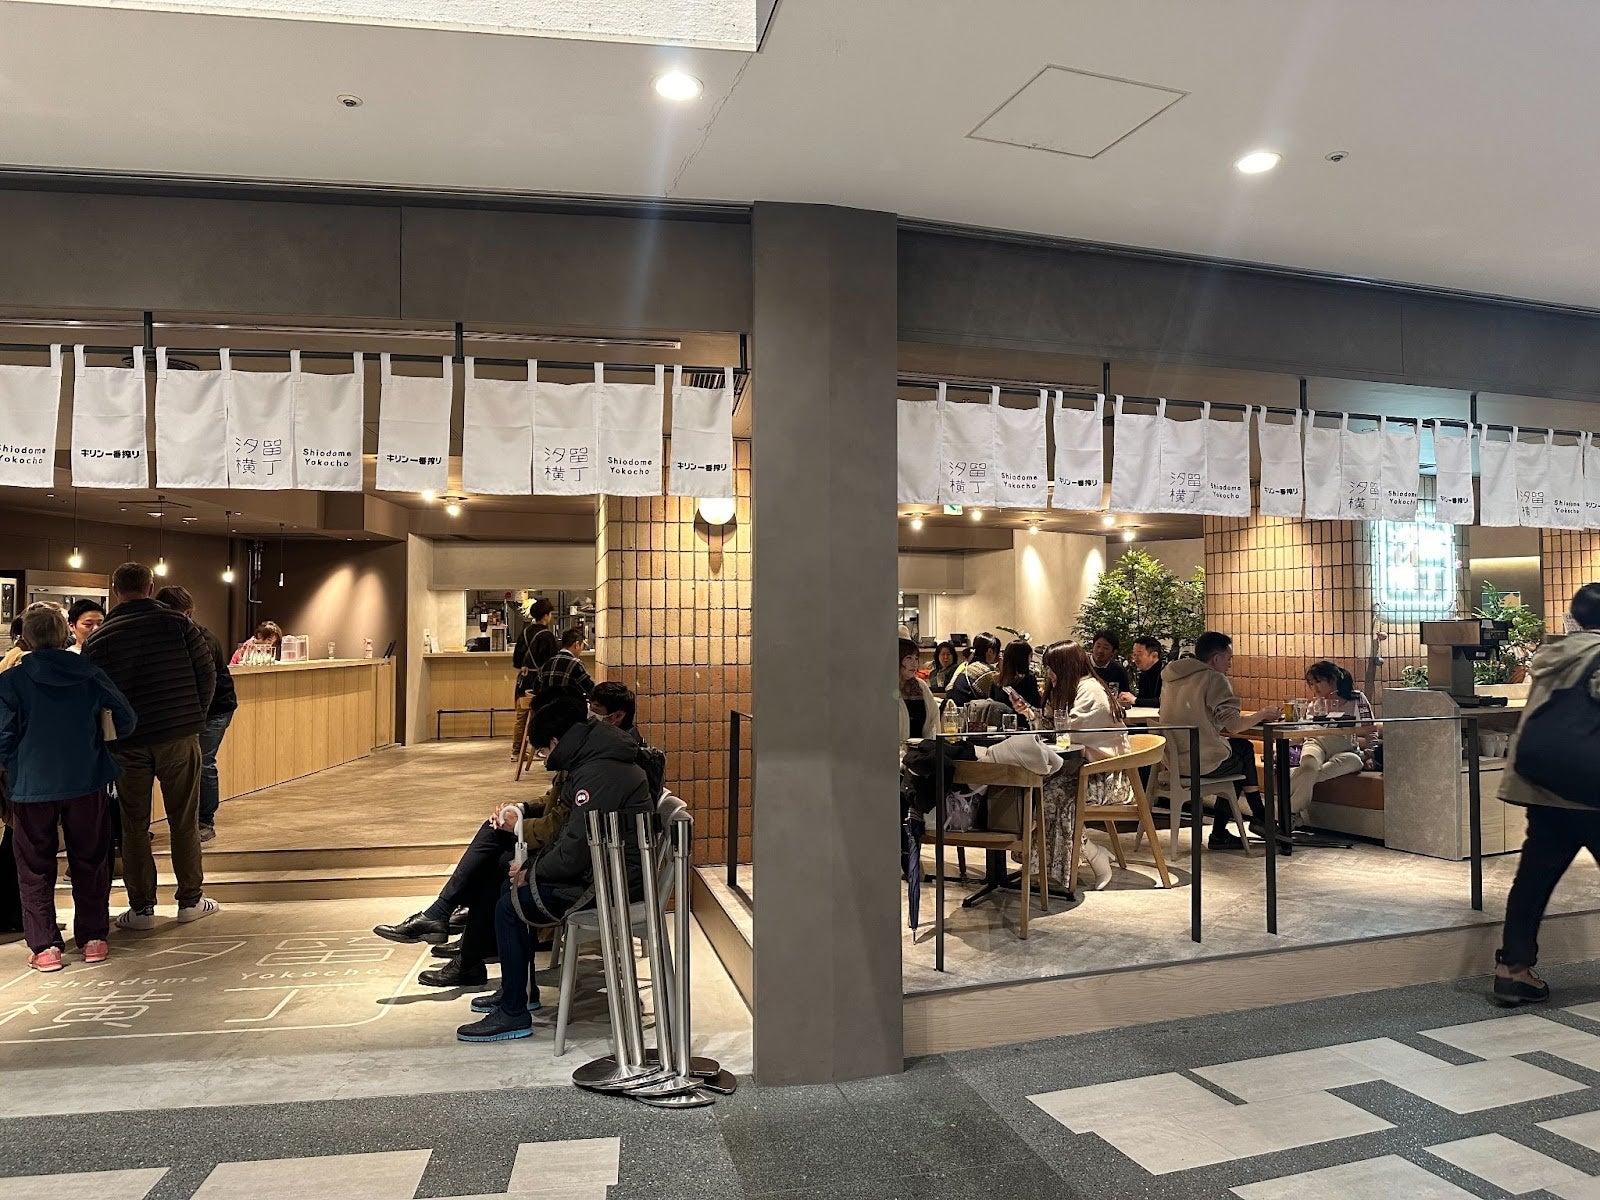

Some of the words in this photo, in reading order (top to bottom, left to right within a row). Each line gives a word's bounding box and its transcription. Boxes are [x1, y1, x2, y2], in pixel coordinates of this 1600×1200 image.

[0, 444, 46, 454] hiodome
[235, 437, 282, 456] 汐留
[81, 449, 140, 459] キリン一番搾り
[302, 448, 352, 457] Shiodome
[544, 446, 588, 464] 汐留
[305, 458, 349, 467] Yokocho
[386, 454, 442, 465] キリン一番搾り
[607, 456, 653, 466] Shiodome
[235, 457, 282, 476] 横丁
[610, 466, 650, 475] Yokocho
[677, 462, 728, 472] キリン一番搾り
[949, 461, 987, 477] 汐留
[544, 466, 589, 482] 横丁
[1001, 472, 1038, 481] Shiodome
[1169, 471, 1201, 487] 汐留
[949, 478, 986, 494] 横丁
[1003, 481, 1037, 489] Yokocho
[1210, 482, 1242, 491] Shiodome
[1169, 488, 1201, 503] 横丁
[1212, 491, 1240, 499] Yokocho
[38, 975, 209, 990] Shiodome
[240, 966, 383, 982] Yokocho
